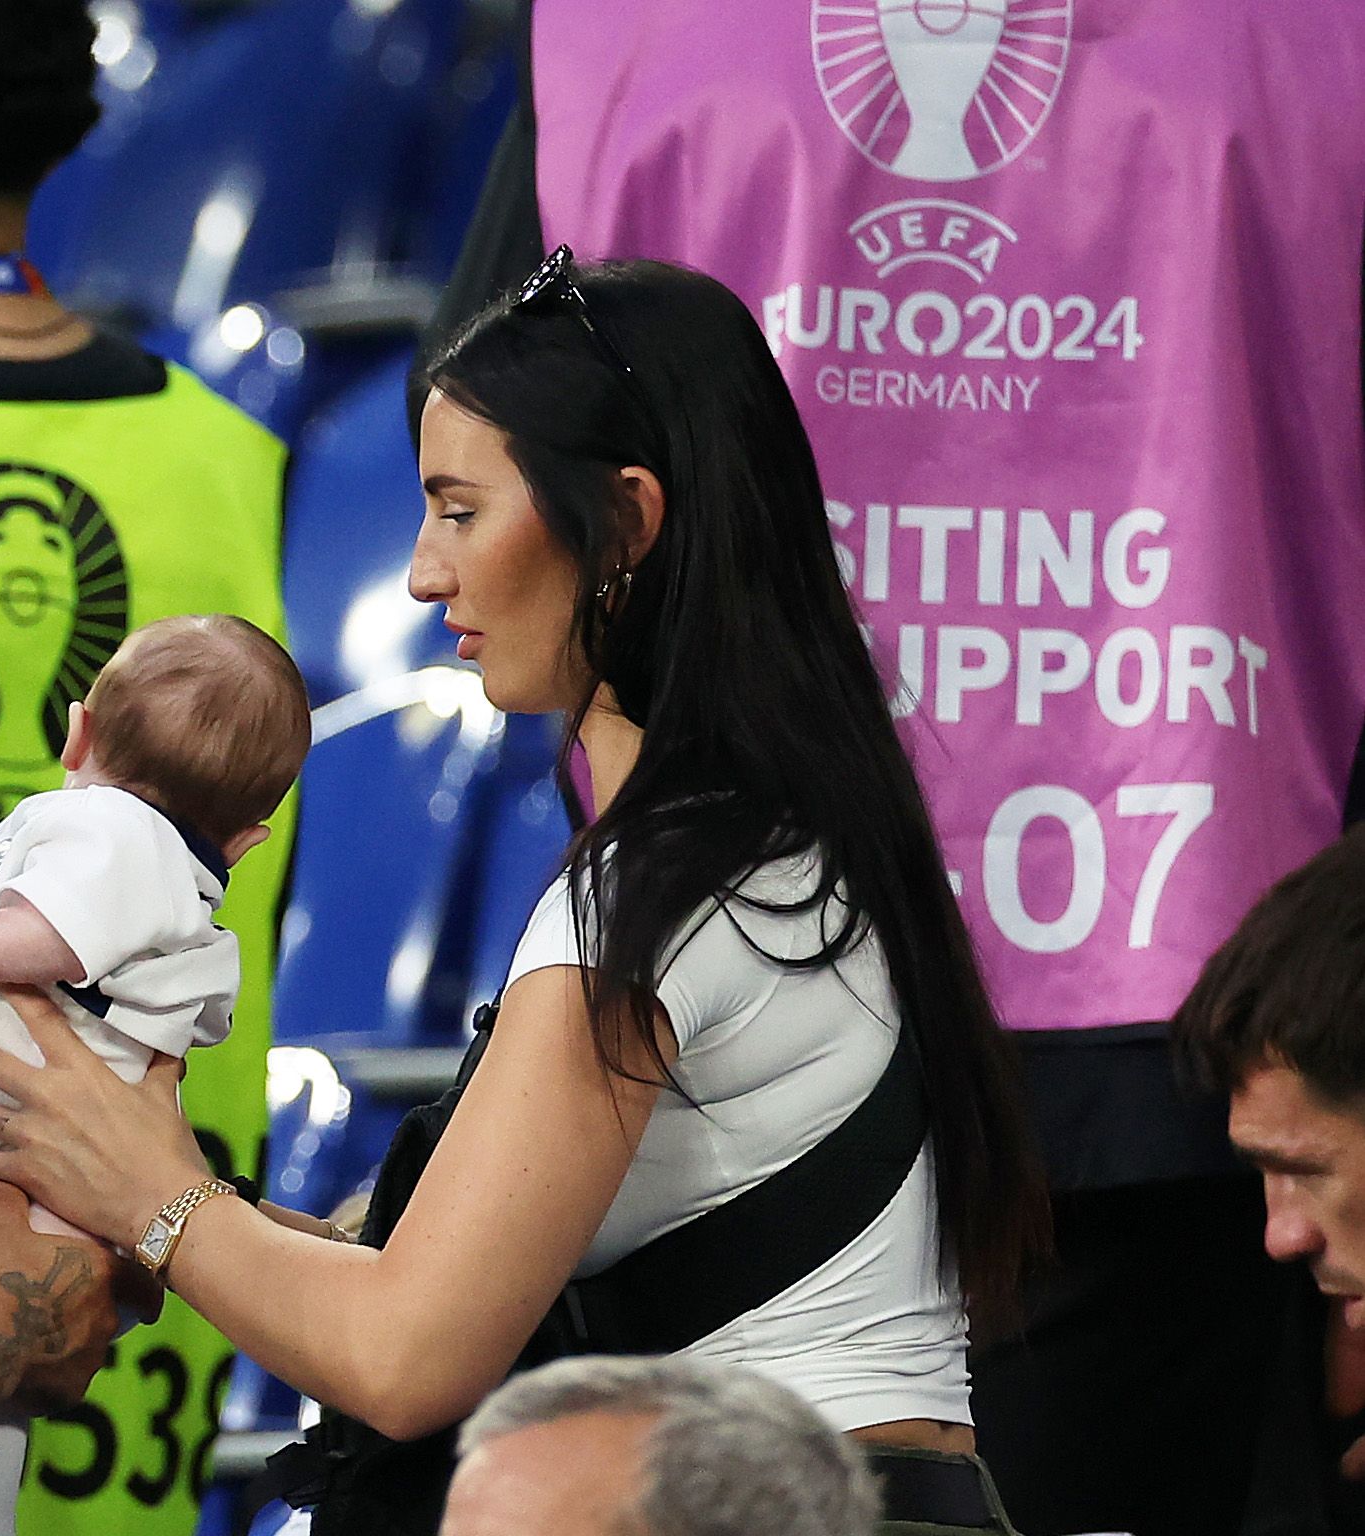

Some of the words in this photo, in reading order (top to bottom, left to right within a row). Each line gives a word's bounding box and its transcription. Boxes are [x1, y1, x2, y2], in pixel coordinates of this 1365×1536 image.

[856, 213, 1001, 273] UEFA
[762, 282, 1145, 362] EURO2024
[815, 364, 1042, 412] GERMANY
